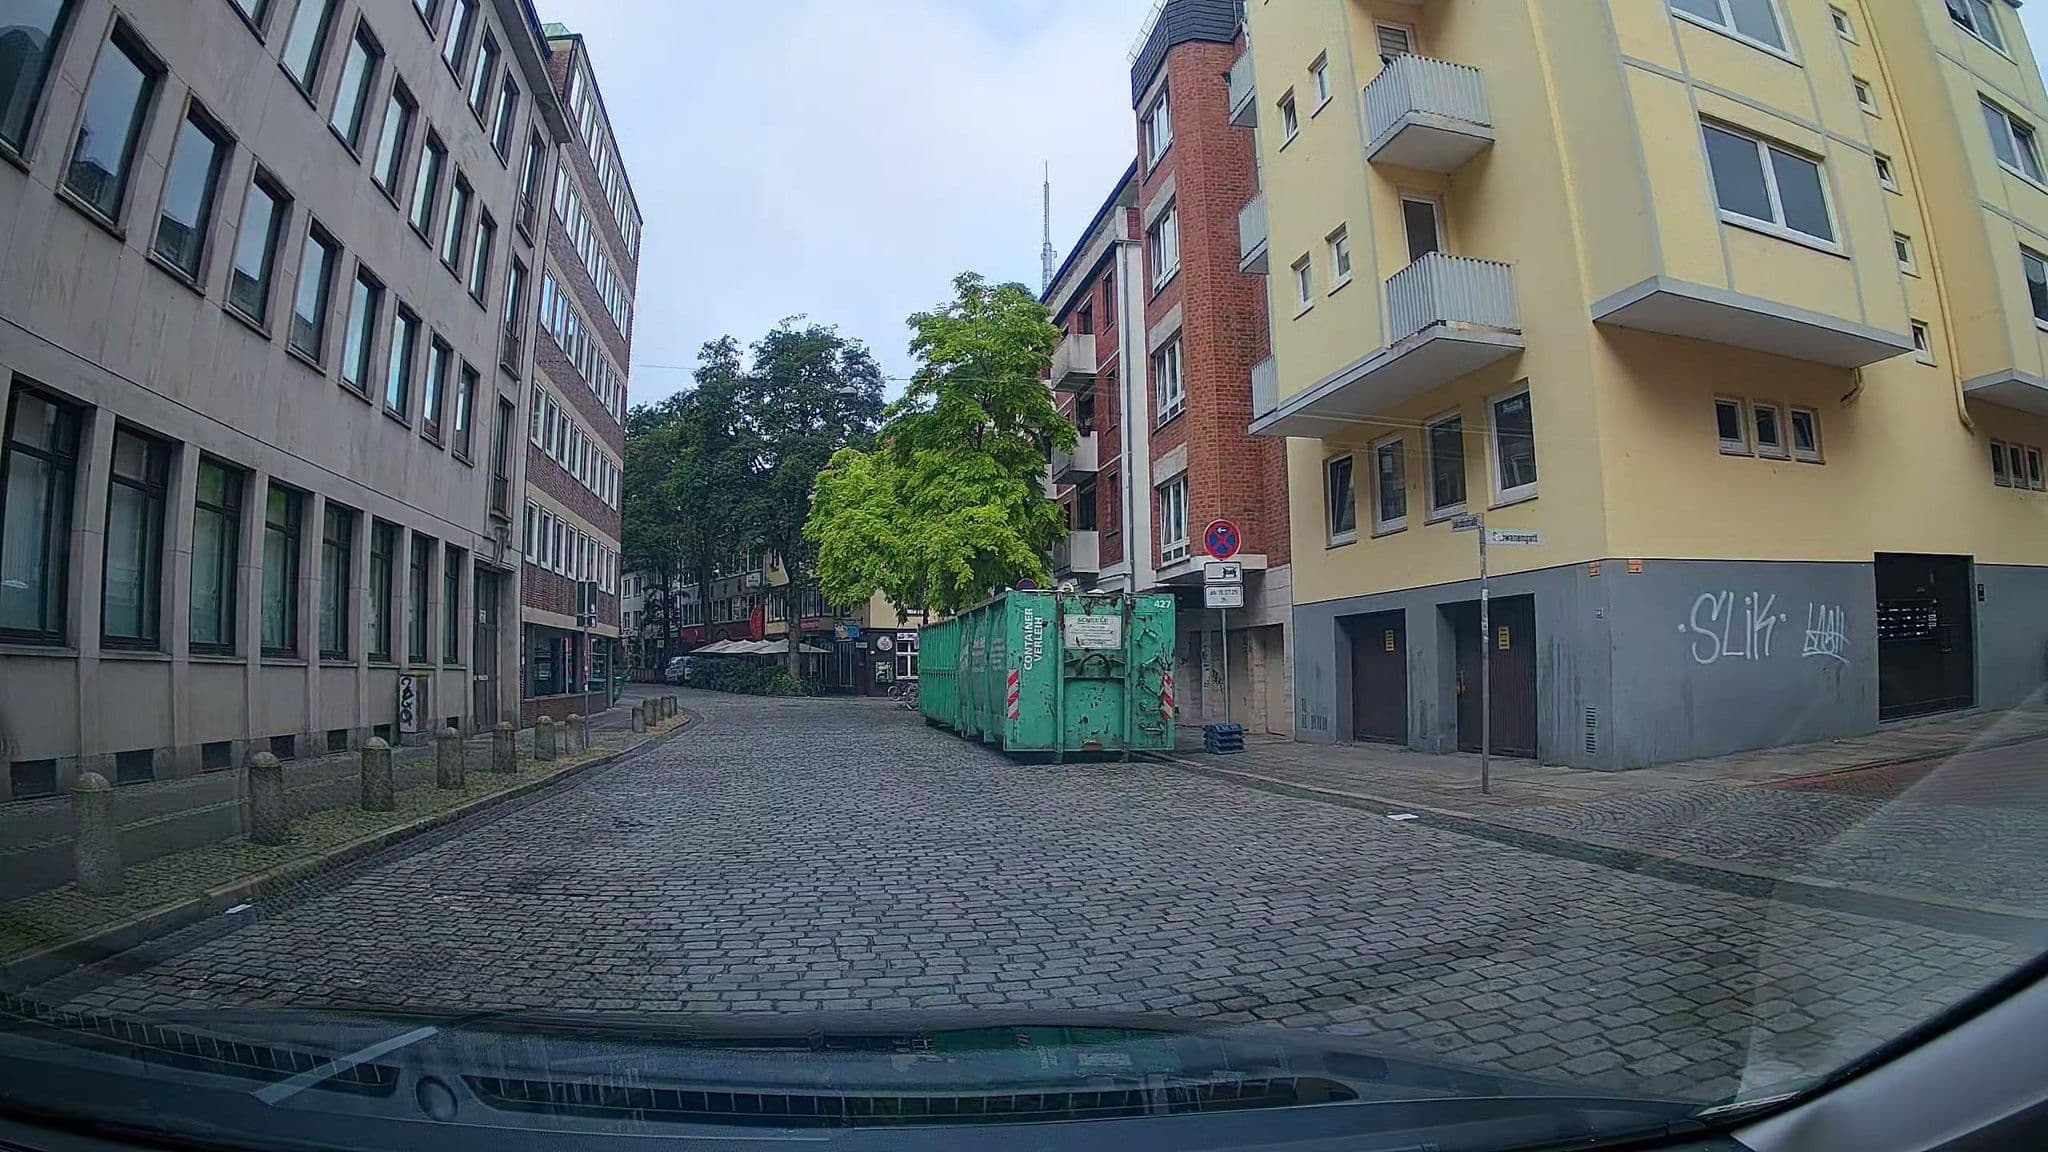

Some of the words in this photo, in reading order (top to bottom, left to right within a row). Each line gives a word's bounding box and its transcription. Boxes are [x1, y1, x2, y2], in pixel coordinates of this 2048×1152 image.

[1154, 600, 1171, 609] 427
[1024, 608, 1033, 671] CONTAINER
[1033, 617, 1043, 662] VERLEIH
